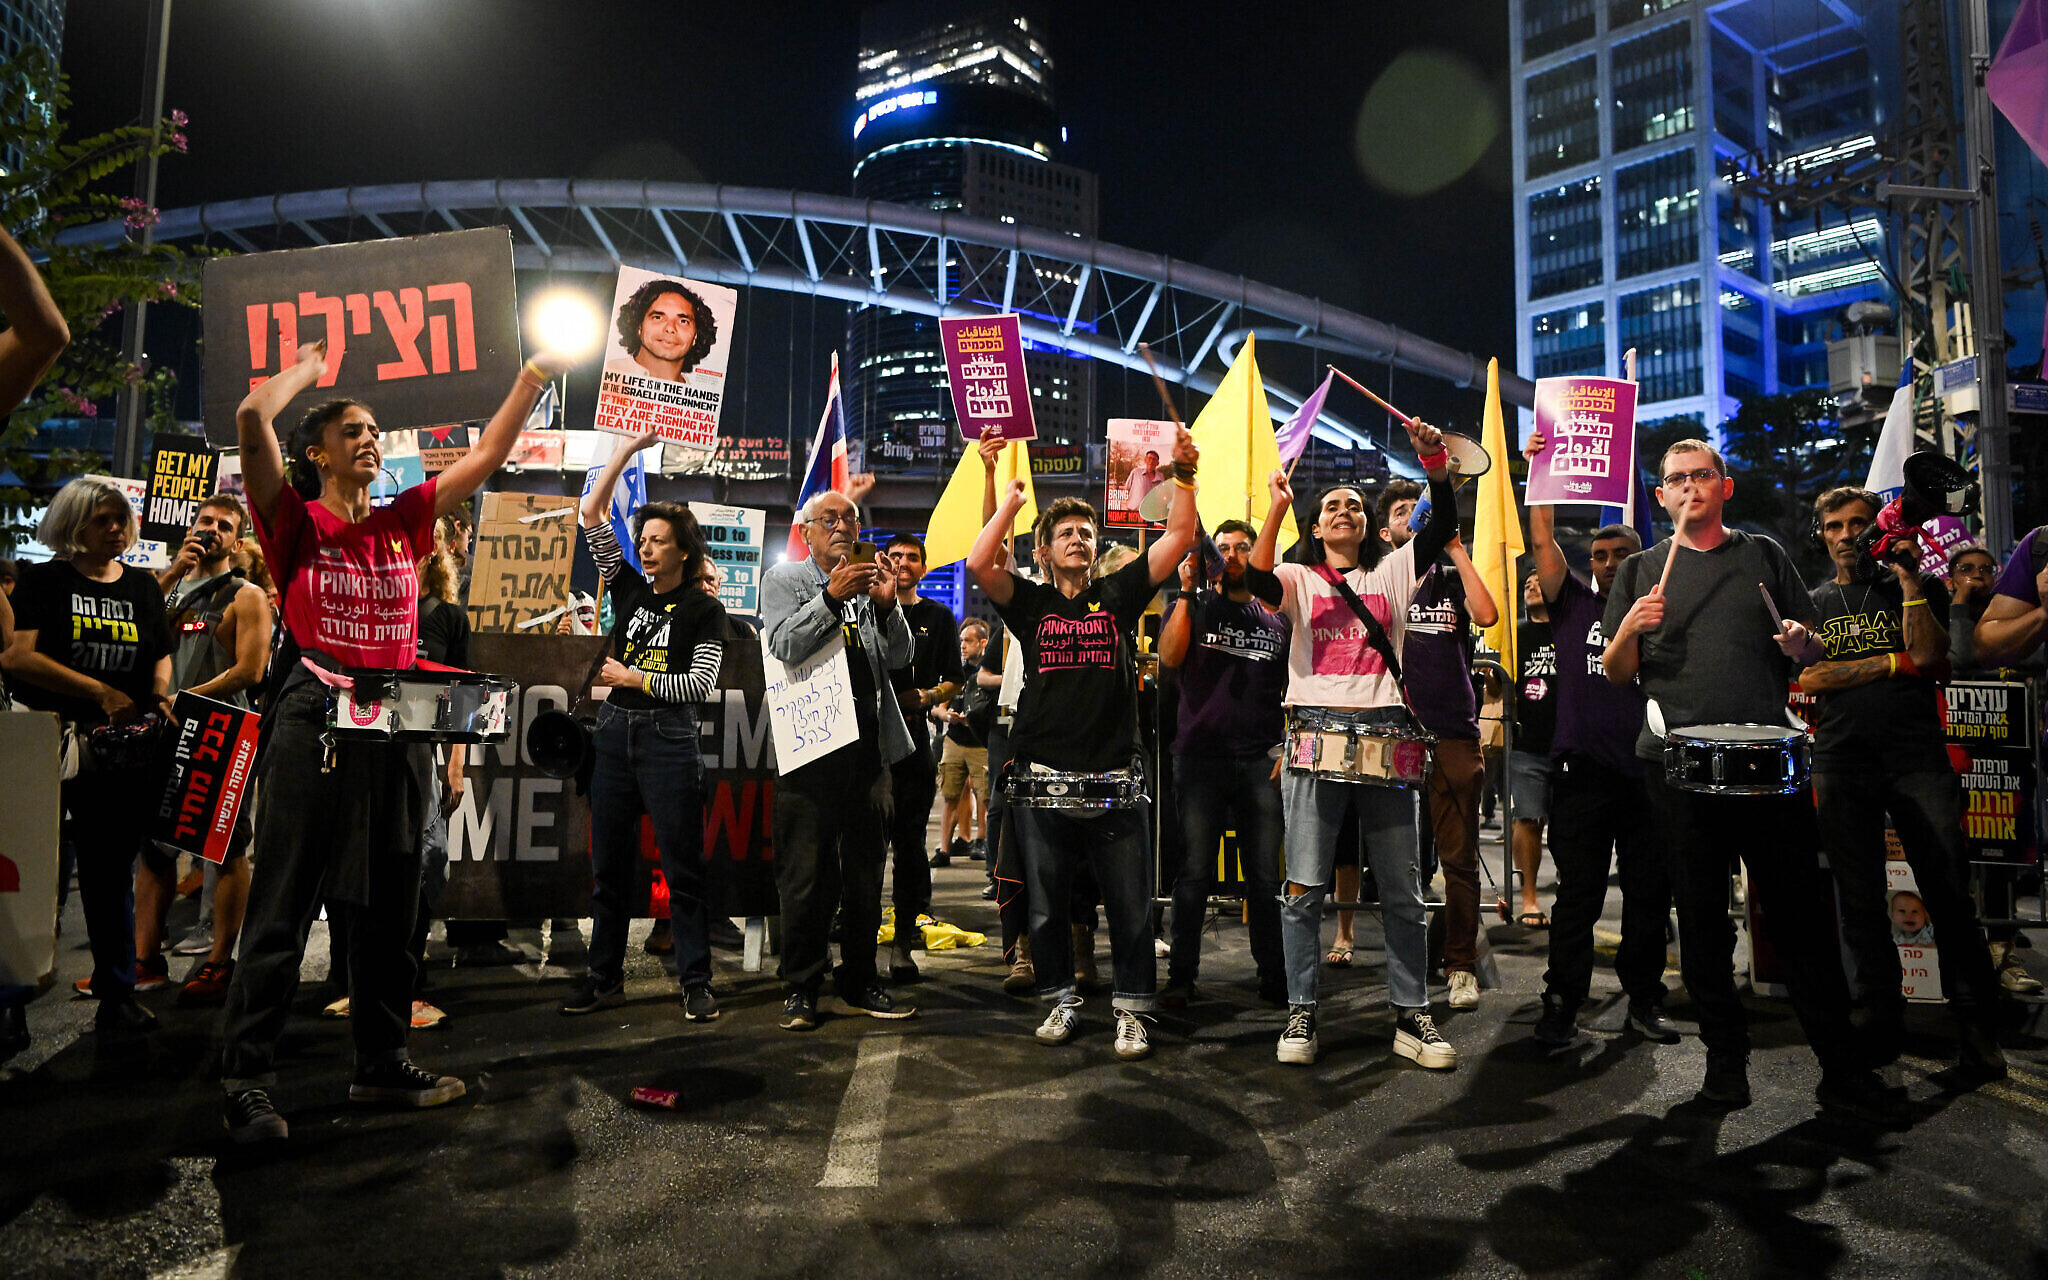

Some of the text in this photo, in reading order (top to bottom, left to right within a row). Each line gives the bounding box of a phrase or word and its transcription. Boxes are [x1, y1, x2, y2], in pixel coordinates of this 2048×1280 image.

[246, 282, 477, 392] הצילו!
[960, 341, 1000, 350] הסכמים
[964, 365, 1005, 376] מצילים
[604, 372, 620, 382] MY
[622, 375, 646, 388] LIFE
[647, 380, 654, 390] IS
[664, 383, 682, 394] THE
[685, 388, 720, 402] HANDS
[601, 394, 716, 423] IF THEY DON'T SIGN A DEAL
[621, 386, 656, 400] ISRAELI
[658, 393, 718, 412] GOVERNMENT
[970, 400, 1010, 414] חיים
[597, 414, 642, 432] DEATH
[600, 403, 715, 434] THEY ARE SIGNING MY
[884, 441, 914, 460] Bring
[156, 450, 212, 478] GET MY
[1554, 458, 1606, 472] חיים
[152, 474, 209, 502] PEOPLE
[1109, 489, 1128, 500] BRING
[732, 528, 746, 542] to
[480, 534, 568, 561] תפחד
[736, 550, 760, 562] war
[320, 570, 412, 600] PINKFRONT
[501, 573, 568, 600] אתה
[735, 569, 749, 582] to
[72, 593, 97, 616] הם
[72, 615, 138, 642] עדיין
[321, 617, 368, 640] הורודה
[1041, 619, 1108, 636] PINKFRONT
[1312, 627, 1344, 642] PINK
[1820, 611, 1900, 640] STAM
[1824, 630, 1896, 659] WARS
[1078, 651, 1110, 662] החזית
[1946, 687, 2008, 712] עוצרים
[1946, 710, 2000, 725] את המדינה
[176, 718, 199, 760] פדיון
[1946, 724, 2008, 740] סוף להפקרה
[174, 711, 232, 840] בכל מחיר
[1972, 758, 2008, 774] טרפדת
[1962, 774, 2020, 790] את העסקה
[1968, 790, 2014, 814] הרגת
[1967, 816, 2016, 840] אותנו
